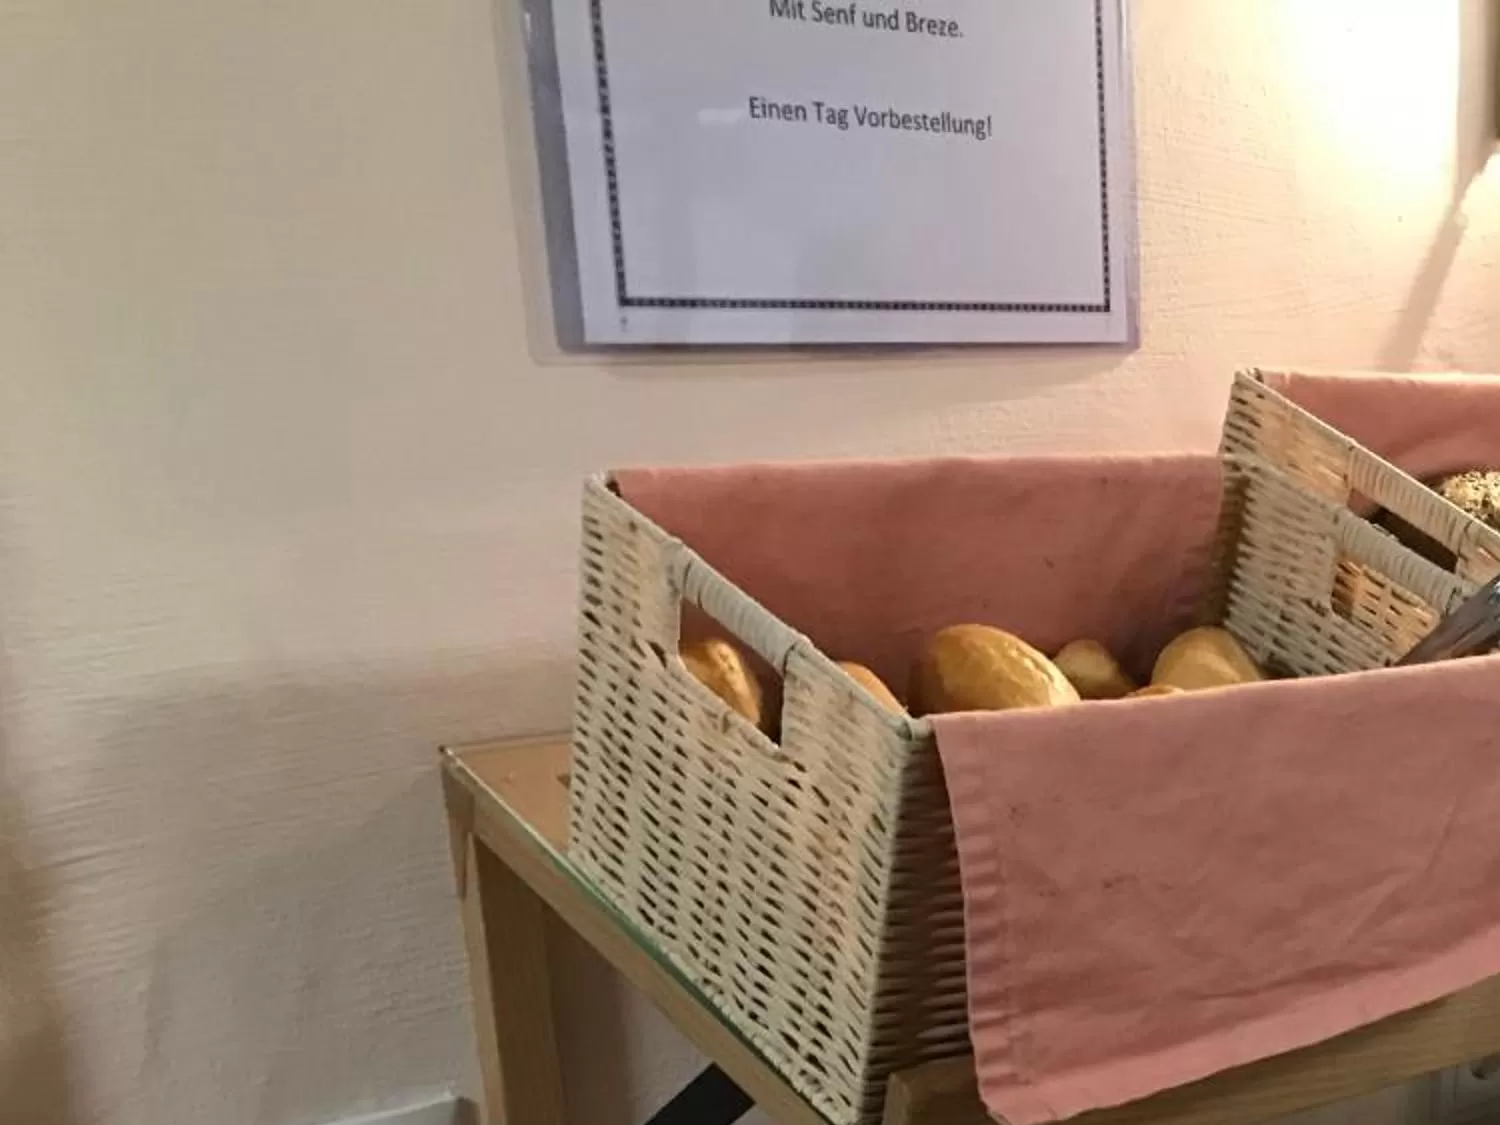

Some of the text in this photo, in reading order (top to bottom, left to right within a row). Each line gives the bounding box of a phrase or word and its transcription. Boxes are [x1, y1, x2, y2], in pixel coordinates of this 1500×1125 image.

[769, 0, 963, 38] Mit Senf und Breze.
[749, 96, 993, 141] Einen Tag Vorbestellung!
